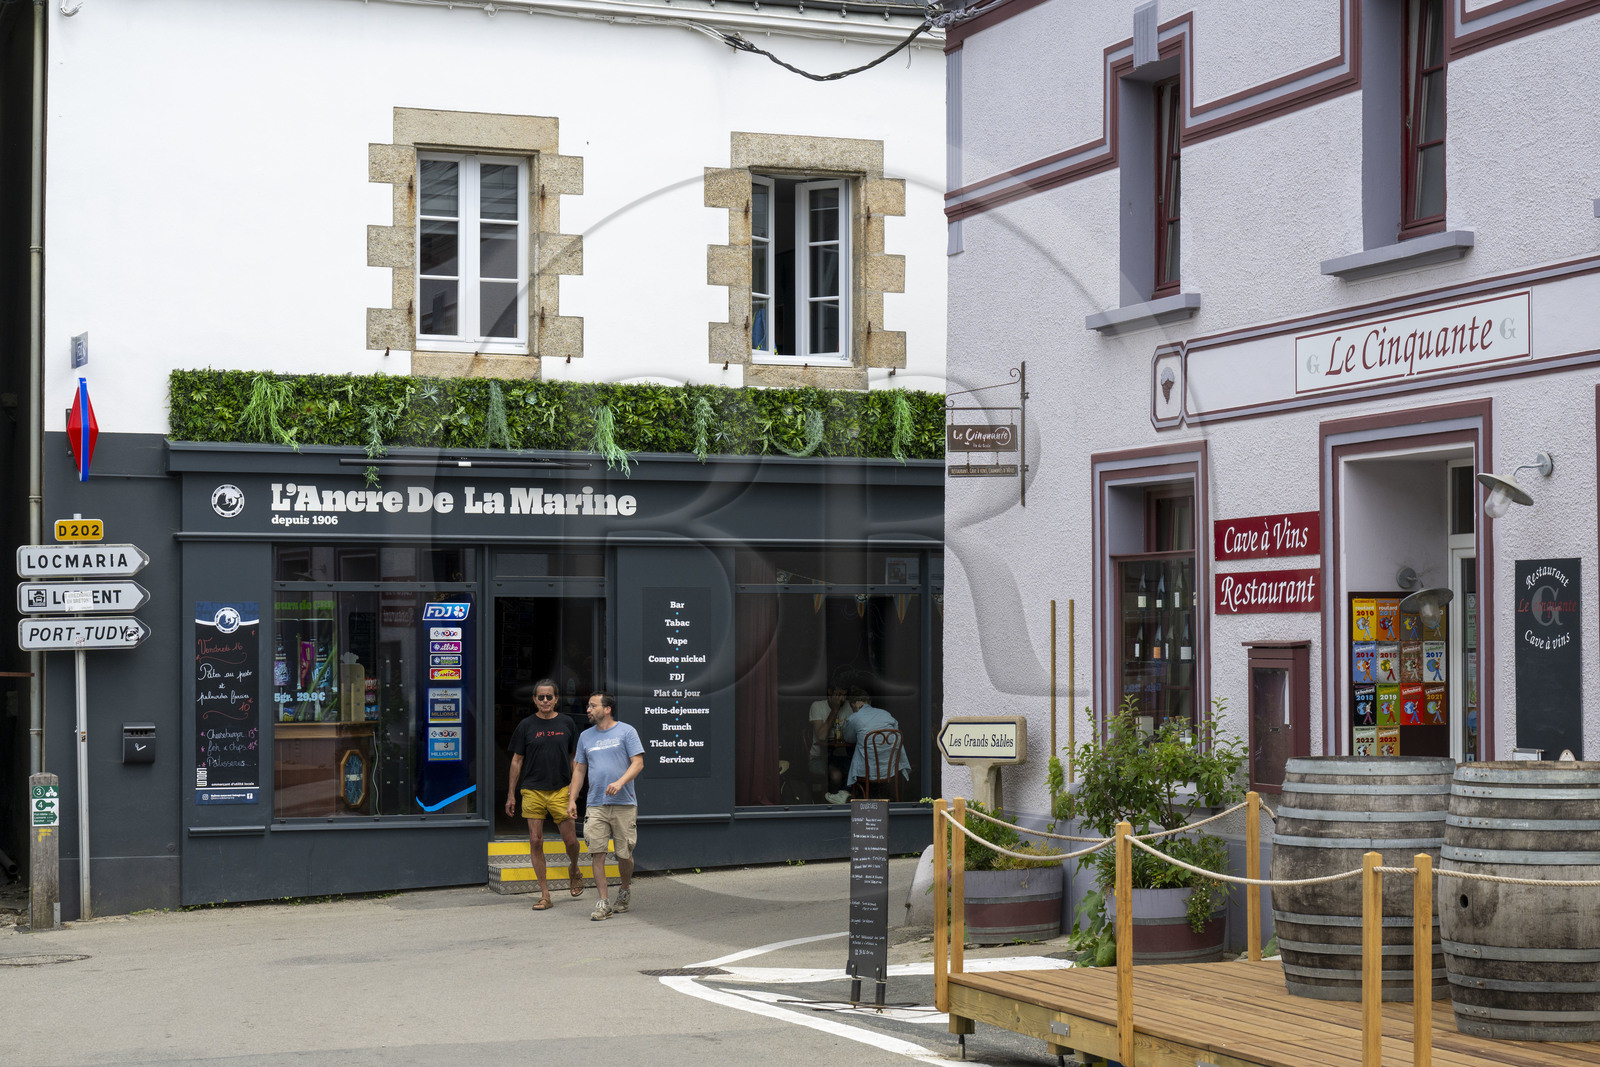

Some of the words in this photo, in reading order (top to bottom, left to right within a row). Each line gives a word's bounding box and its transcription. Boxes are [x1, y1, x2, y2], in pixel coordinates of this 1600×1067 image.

[1325, 336, 1356, 376] Le
[1362, 316, 1493, 377] Cinquante
[953, 430, 963, 440] Le
[407, 486, 454, 514] De
[464, 486, 505, 514] La
[510, 486, 637, 516] Marine
[271, 515, 310, 526] depuis
[312, 516, 338, 525] 1906
[59, 526, 66, 536] D
[71, 525, 100, 536] 202
[1224, 526, 1258, 554] Cave
[1261, 522, 1270, 551] à
[1273, 517, 1308, 550] Vins
[27, 554, 128, 568] LOCMARIA
[1525, 566, 1569, 590] Restaurant
[1220, 575, 1315, 612] Restaurant
[427, 606, 452, 617] FDJ
[1518, 598, 1529, 612] Le
[29, 626, 128, 642] PORT-TUDY
[1525, 630, 1544, 649] Cave
[1546, 636, 1550, 649] à
[1552, 632, 1570, 649] vins
[667, 637, 688, 646] Vape
[648, 655, 679, 664] Compte
[670, 673, 685, 682] FDJ
[684, 689, 700, 698] jour
[949, 734, 962, 747] Les
[964, 734, 988, 747] Grands
[991, 734, 1013, 747] Sables
